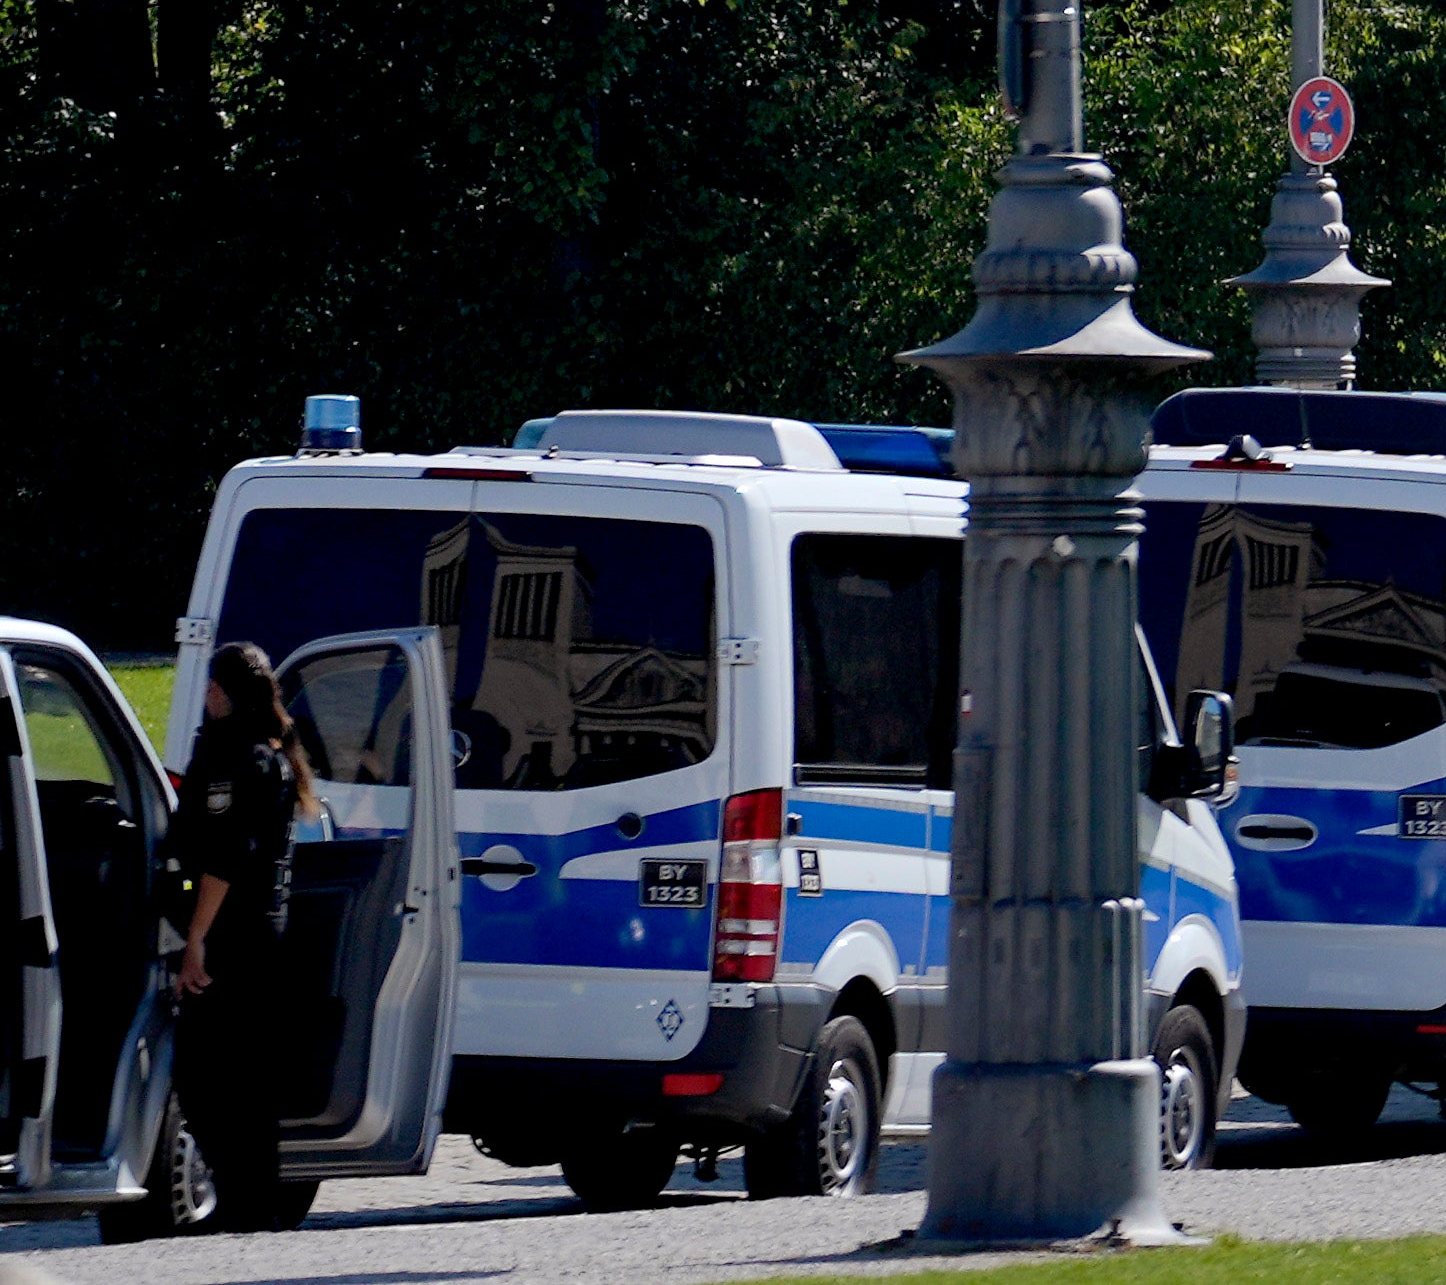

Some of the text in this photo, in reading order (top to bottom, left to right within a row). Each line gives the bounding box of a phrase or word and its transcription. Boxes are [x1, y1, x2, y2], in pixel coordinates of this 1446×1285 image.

[1415, 800, 1445, 816] BY
[658, 864, 688, 881] BY
[647, 885, 700, 903] 1323
